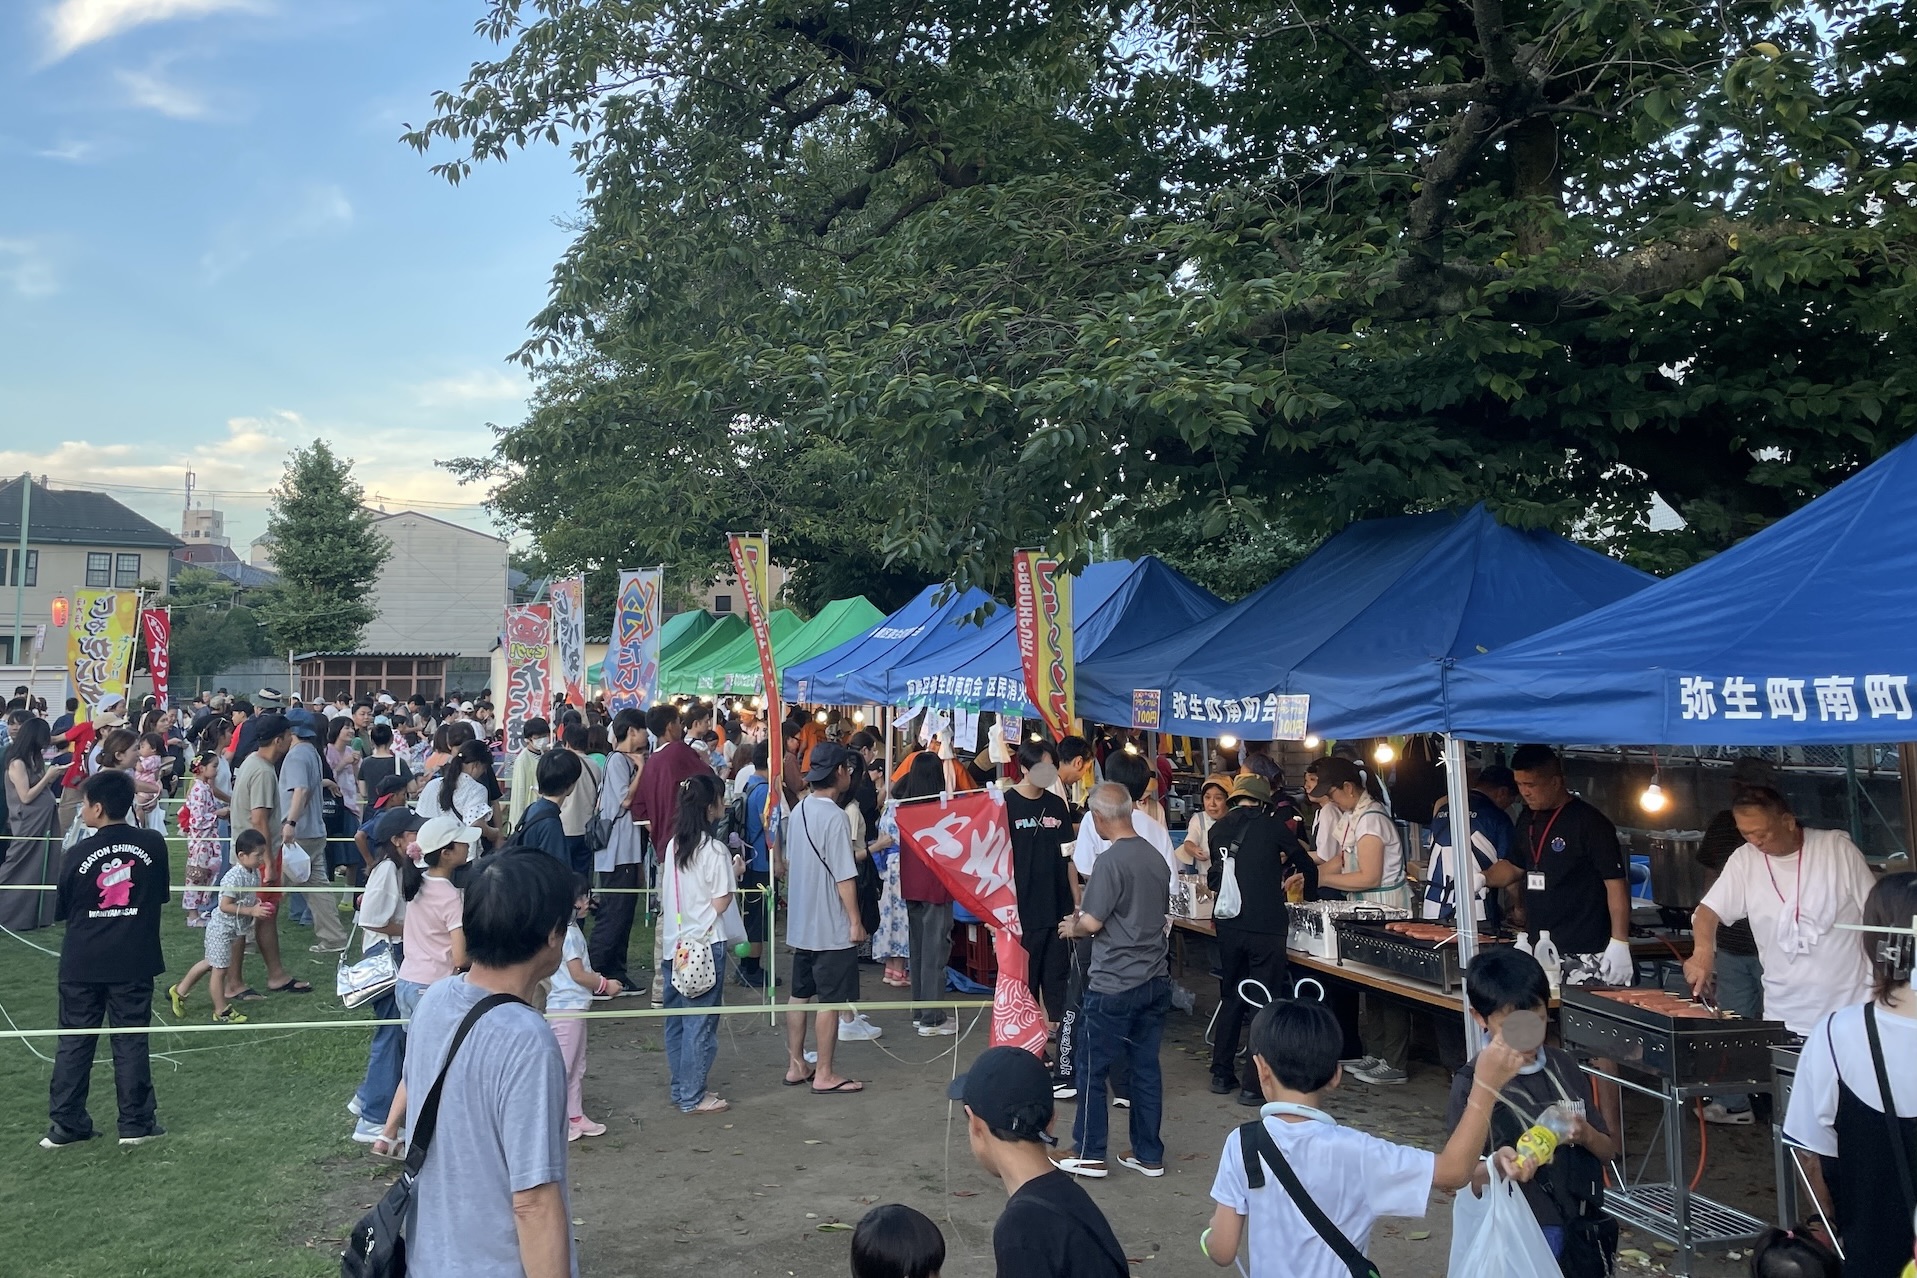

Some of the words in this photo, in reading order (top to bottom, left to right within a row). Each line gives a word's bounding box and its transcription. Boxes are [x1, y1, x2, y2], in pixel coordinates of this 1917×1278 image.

[985, 677, 1031, 703] 区民消火
[1679, 674, 1913, 721] 弥生町南町
[1137, 710, 1157, 724] 100円
[1173, 691, 1278, 723] 弥生町南町会
[1015, 818, 1037, 829] FILA
[79, 846, 110, 874] CRAYON
[112, 844, 153, 866] SHINCHAN
[1060, 1010, 1076, 1076] Reebok
